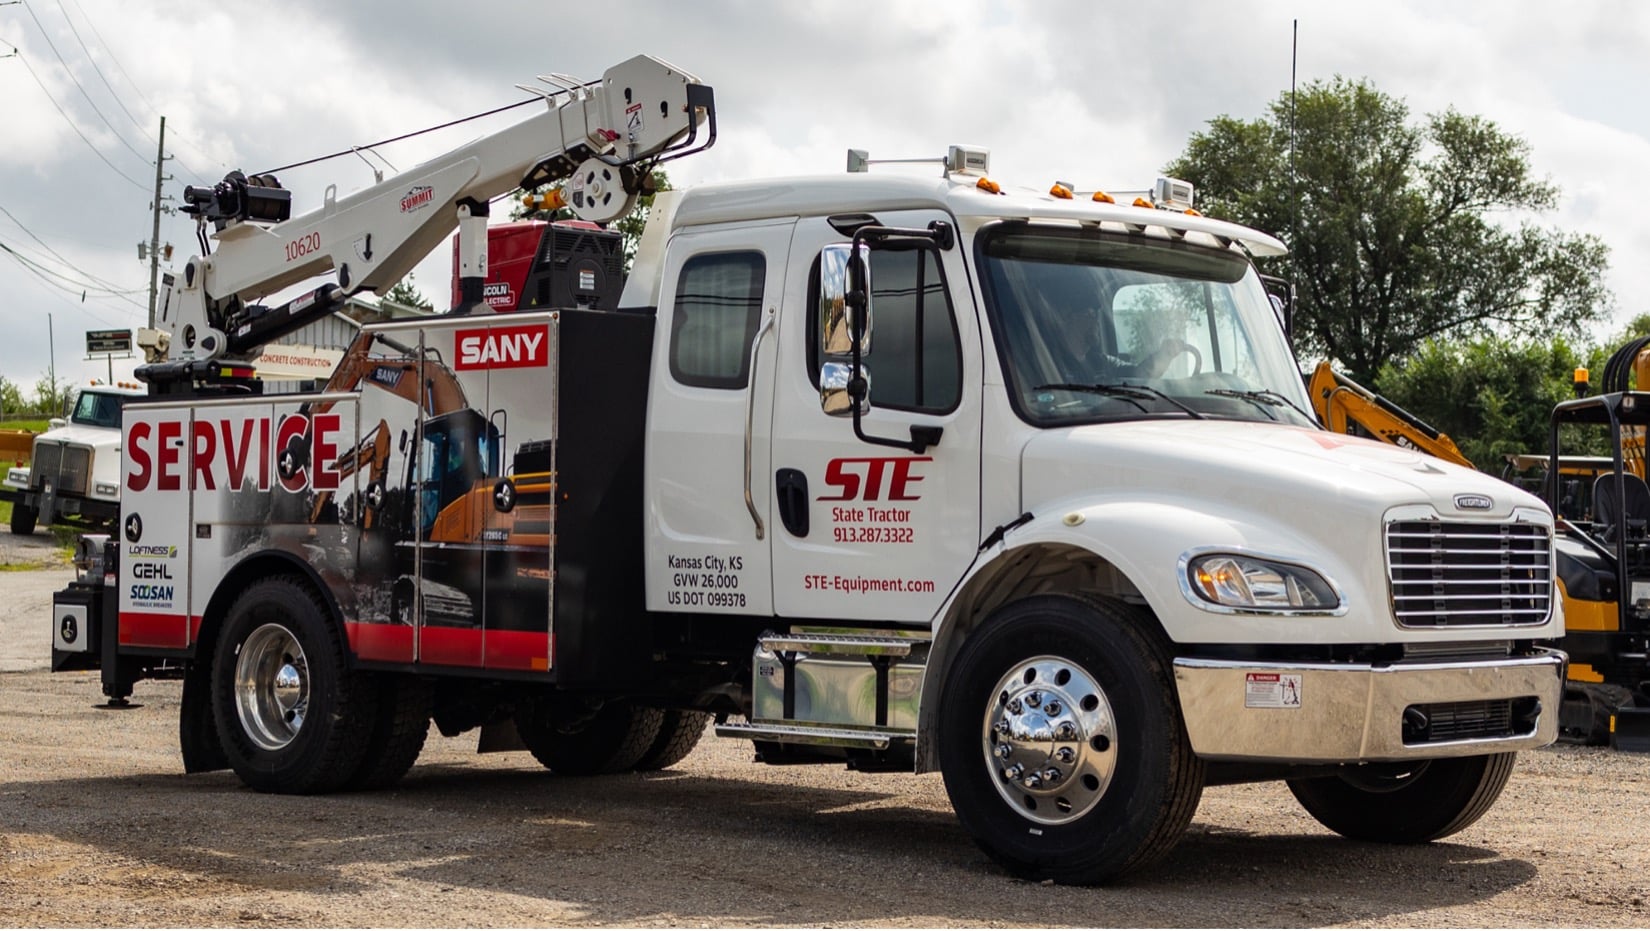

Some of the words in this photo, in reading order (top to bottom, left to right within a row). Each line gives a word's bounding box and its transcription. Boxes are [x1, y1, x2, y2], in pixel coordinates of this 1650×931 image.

[400, 188, 433, 212] SUMMIT
[285, 232, 320, 262] 10620
[483, 285, 507, 296] COLN
[483, 296, 511, 304] LECTRIC
[461, 332, 543, 365] SANY
[260, 354, 289, 365] CONCRETE
[376, 368, 399, 384] SANY
[127, 415, 341, 493] SERVICE
[816, 456, 933, 502] STE
[832, 507, 864, 523] State
[867, 508, 911, 523] Tractor
[833, 527, 914, 543] 913.287.3322
[129, 546, 169, 555] LOFTNESS
[132, 563, 173, 580] GEHL
[668, 555, 702, 569] Kansas
[704, 555, 727, 573] City,
[729, 556, 743, 570] KS
[673, 573, 699, 587] GVW
[701, 574, 739, 590] 26,000
[804, 575, 935, 594] STE-Equipment.com
[130, 584, 174, 601] SOOSAN
[667, 591, 682, 605] US
[683, 591, 705, 606] DOT
[707, 592, 747, 608] 099378
